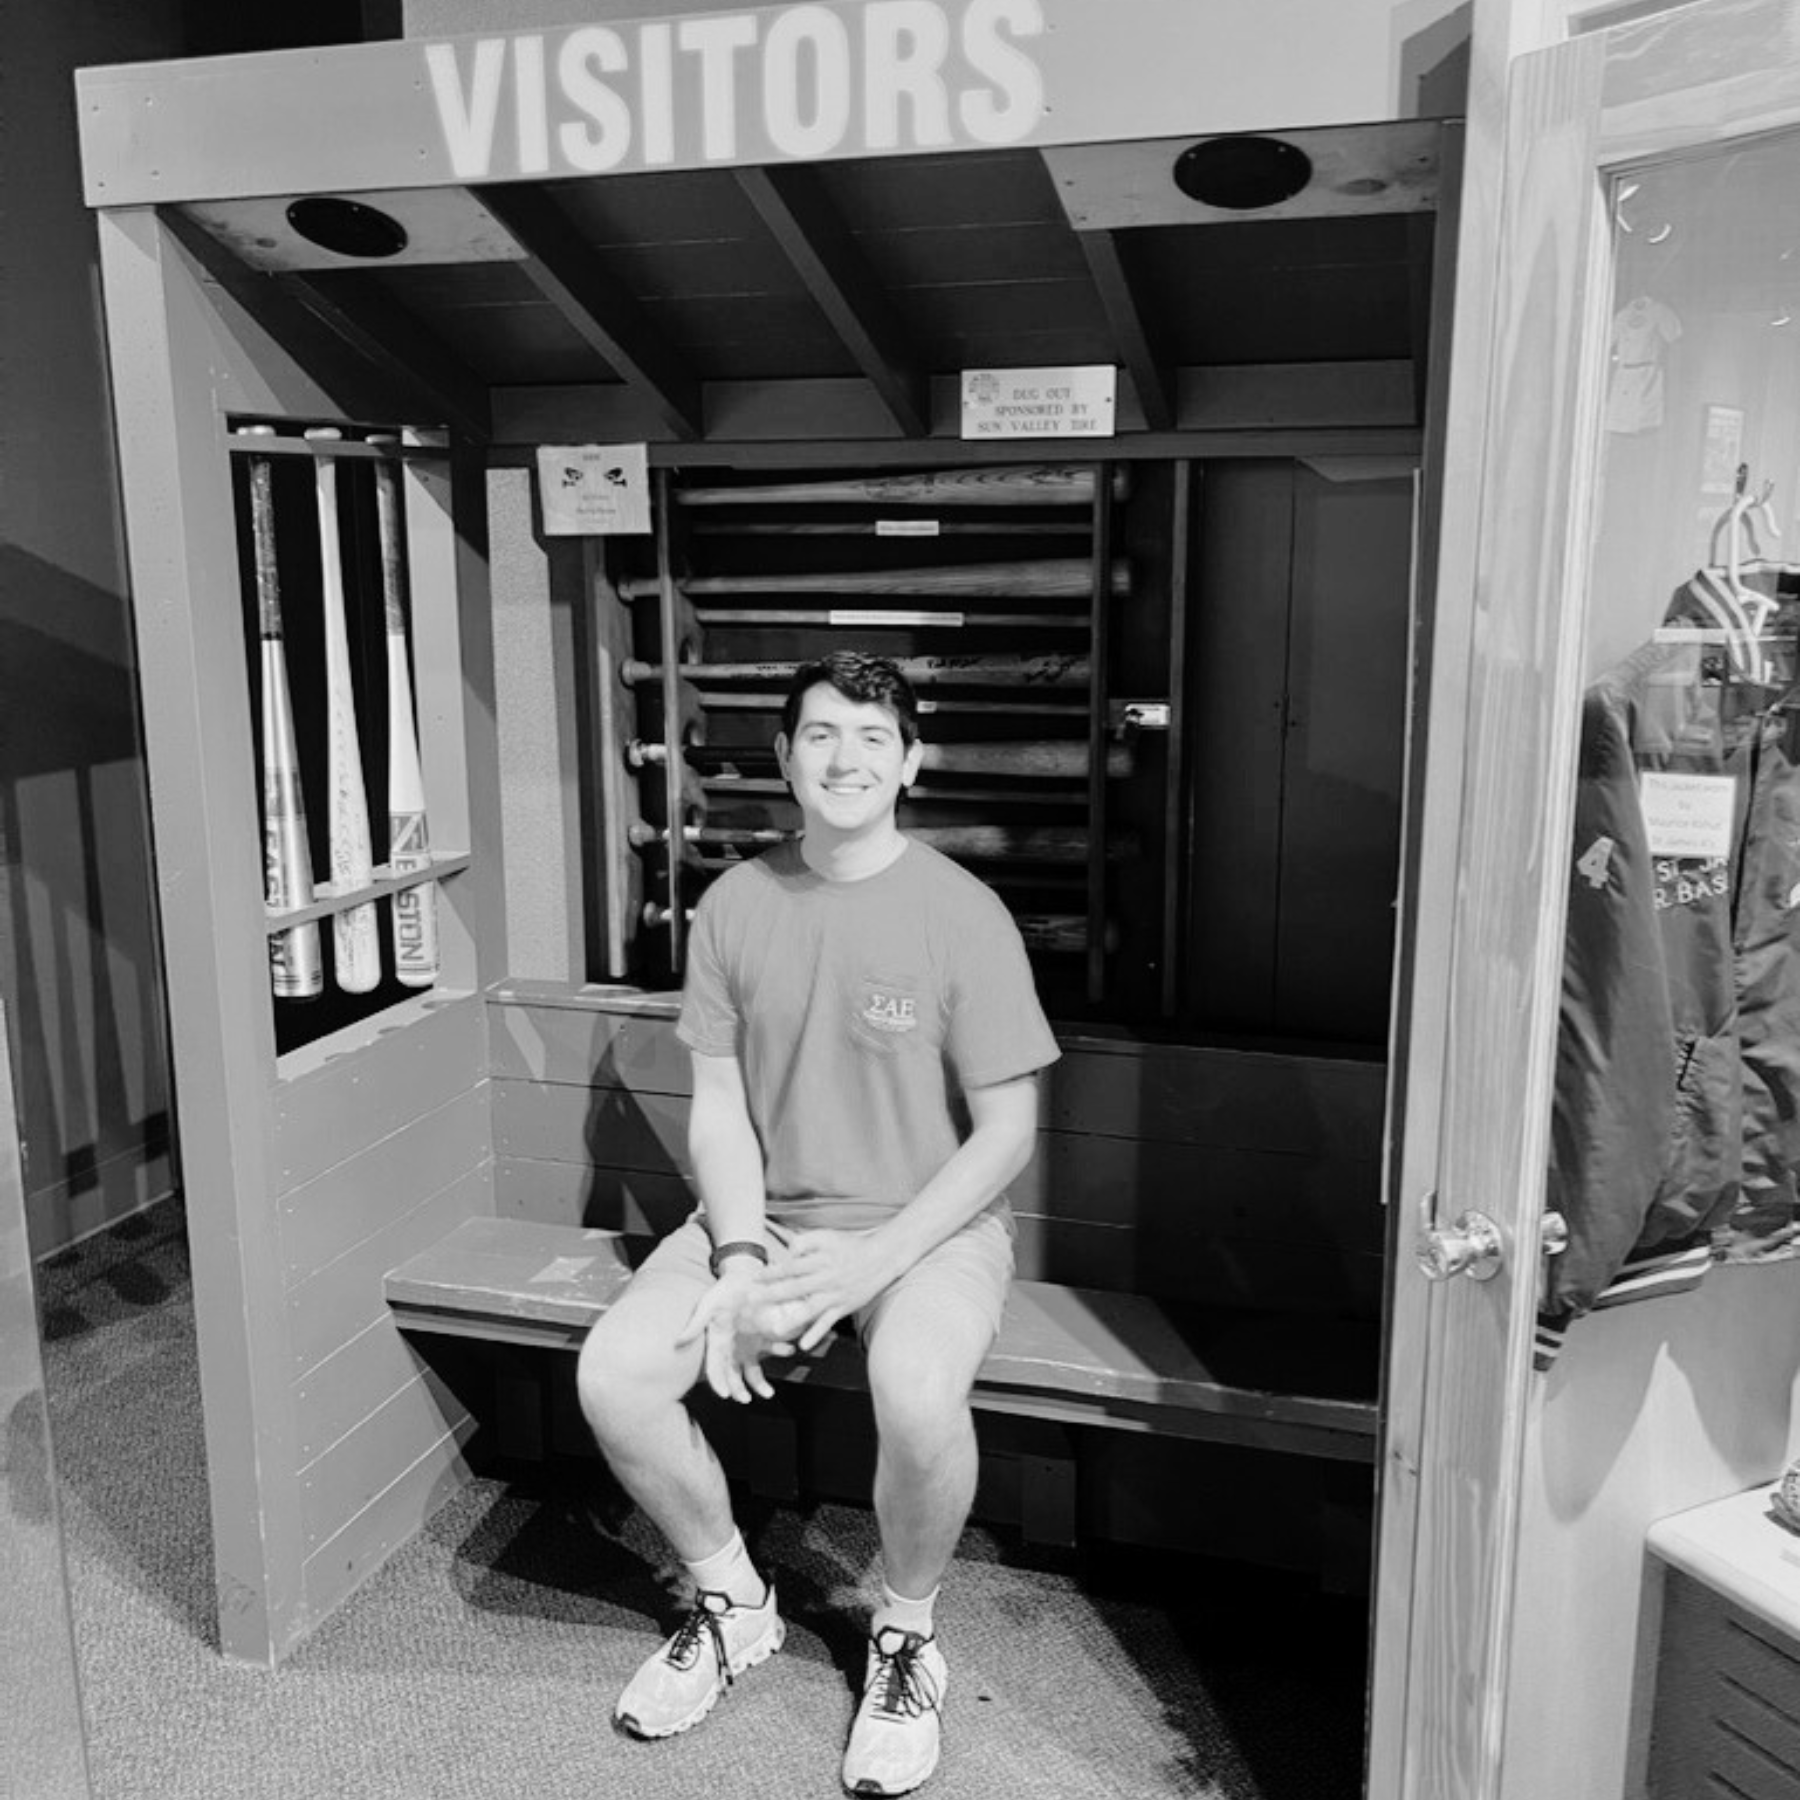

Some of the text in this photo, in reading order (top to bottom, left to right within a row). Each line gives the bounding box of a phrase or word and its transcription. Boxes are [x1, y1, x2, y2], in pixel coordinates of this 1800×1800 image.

[424, 0, 1044, 177] VISITORS
[995, 404, 1088, 416] SPONSORED BY
[1046, 387, 1071, 400] OUT
[978, 421, 1001, 433] SUN
[1011, 420, 1060, 432] VALLEY
[1577, 836, 1614, 889] 4
[396, 858, 425, 961] ESTON
